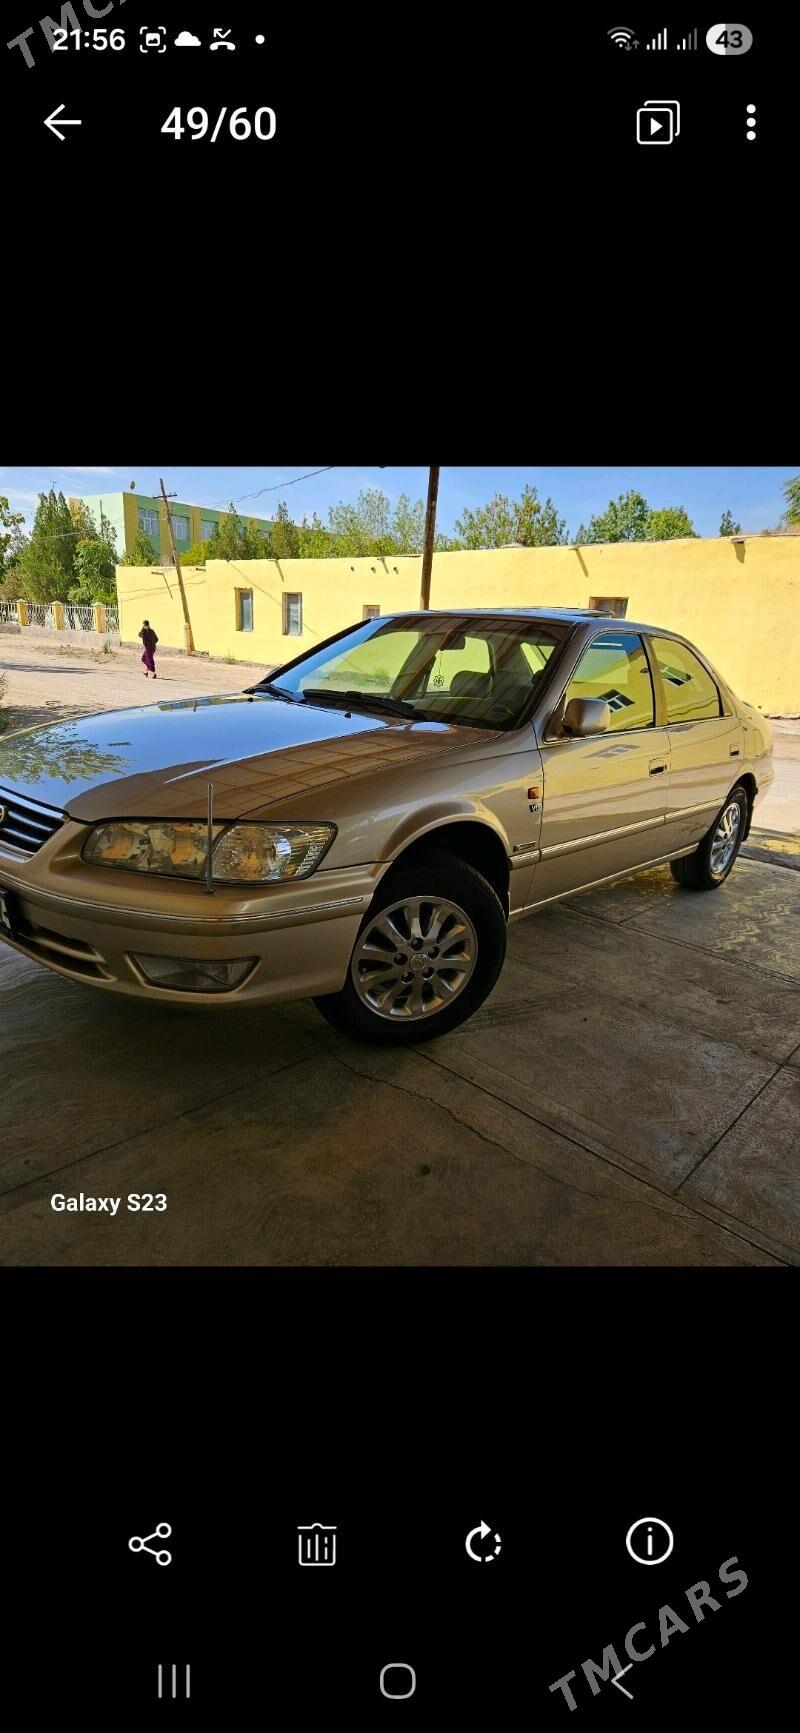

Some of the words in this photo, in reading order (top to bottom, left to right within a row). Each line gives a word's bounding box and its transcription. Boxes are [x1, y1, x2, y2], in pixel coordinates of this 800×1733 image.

[53, 28, 126, 51] 21:56
[715, 30, 743, 48] 43
[160, 106, 277, 142] 49/60
